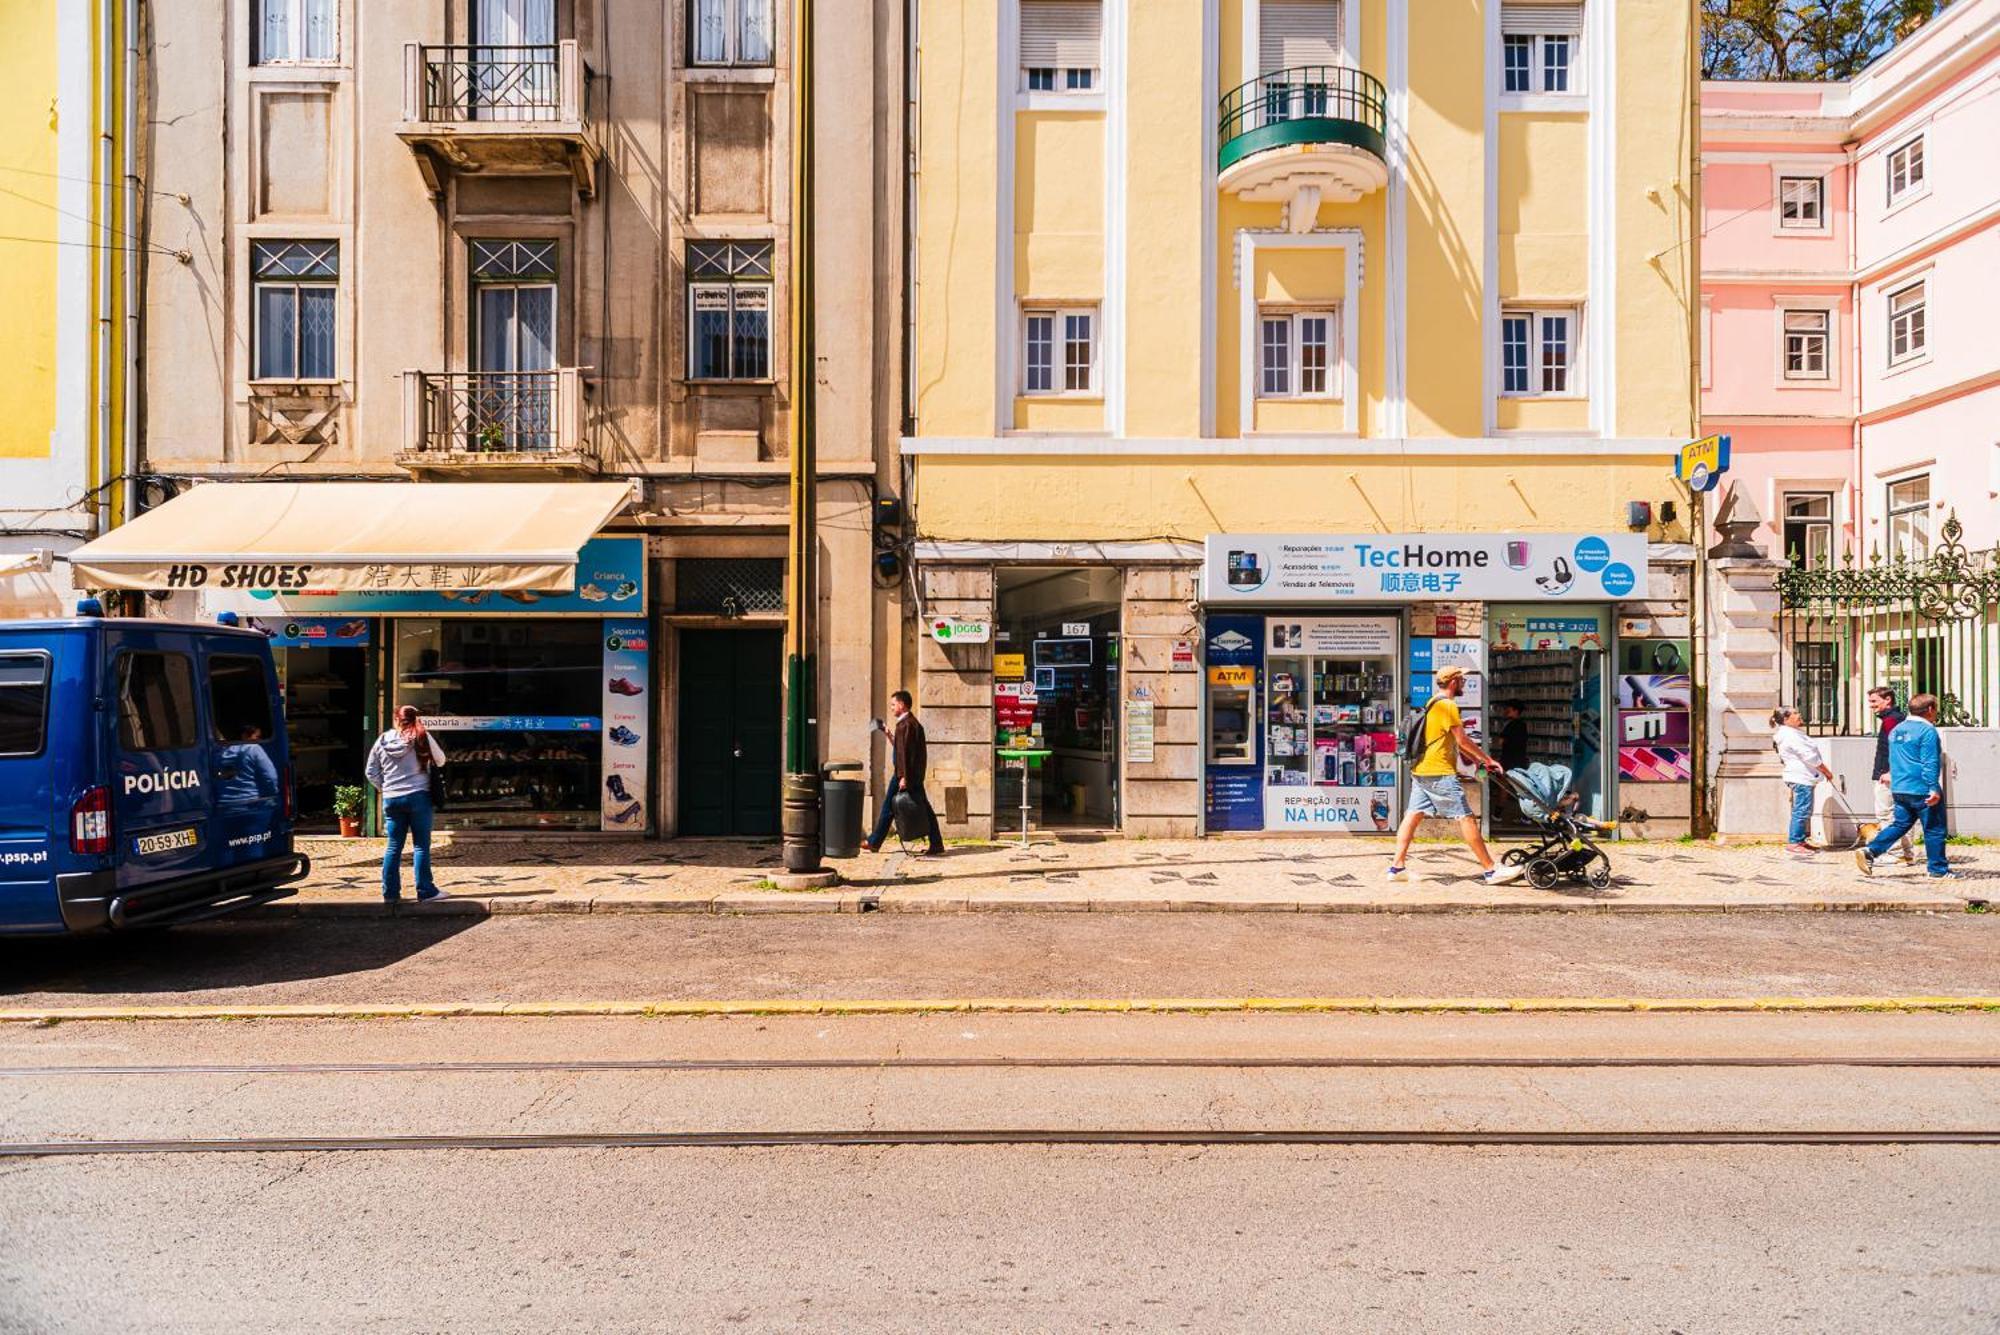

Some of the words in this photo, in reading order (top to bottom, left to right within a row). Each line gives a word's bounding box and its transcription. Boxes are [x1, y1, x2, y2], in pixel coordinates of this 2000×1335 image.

[1689, 440, 1714, 459] ATM
[1354, 544, 1489, 568] TecHome
[168, 564, 208, 588] HD
[220, 564, 313, 588] SHOES
[367, 565, 482, 588] 浩大鞋业
[1380, 572, 1462, 593] 顺意电子
[1065, 624, 1086, 634] 167
[1216, 671, 1247, 681] ATM
[124, 766, 200, 794] POLÍCIA
[1336, 797, 1360, 805] FEITA
[1285, 808, 1308, 822] NA
[1314, 808, 1360, 822] HORA
[228, 831, 272, 847] www.psp.pt
